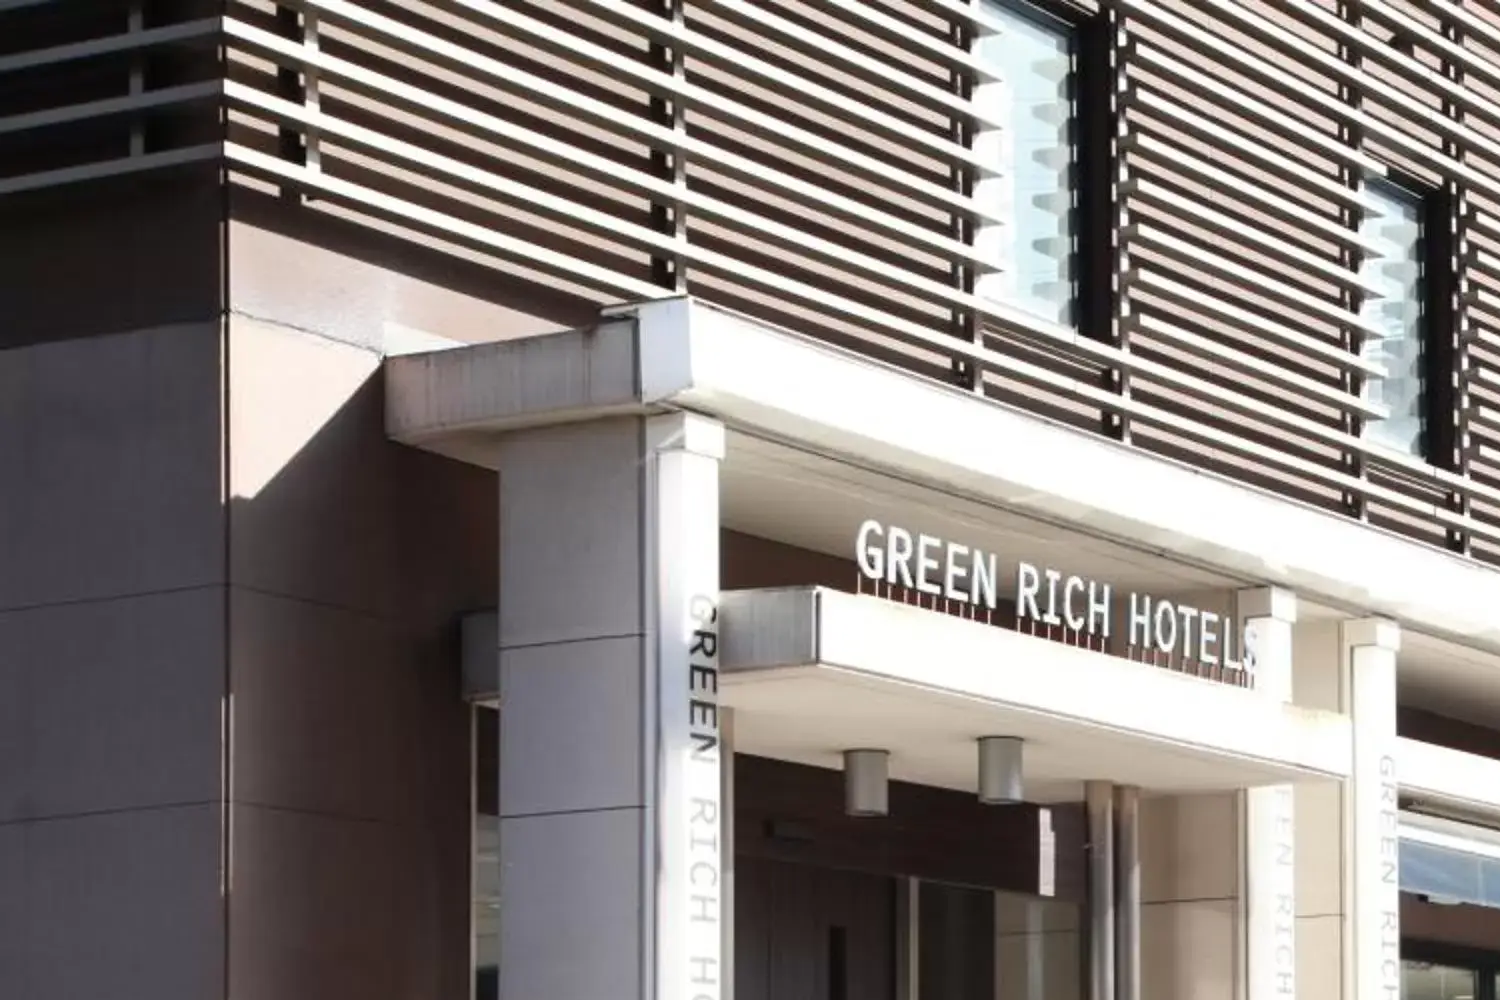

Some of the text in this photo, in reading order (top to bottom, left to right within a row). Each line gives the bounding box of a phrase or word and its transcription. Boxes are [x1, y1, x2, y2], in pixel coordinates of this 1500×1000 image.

[855, 519, 1257, 674] GREEN RICH HOTELS
[688, 593, 718, 763] GREEN
[688, 796, 718, 925] RICH
[1379, 755, 1397, 884] GREEN
[1274, 892, 1295, 994] RICH
